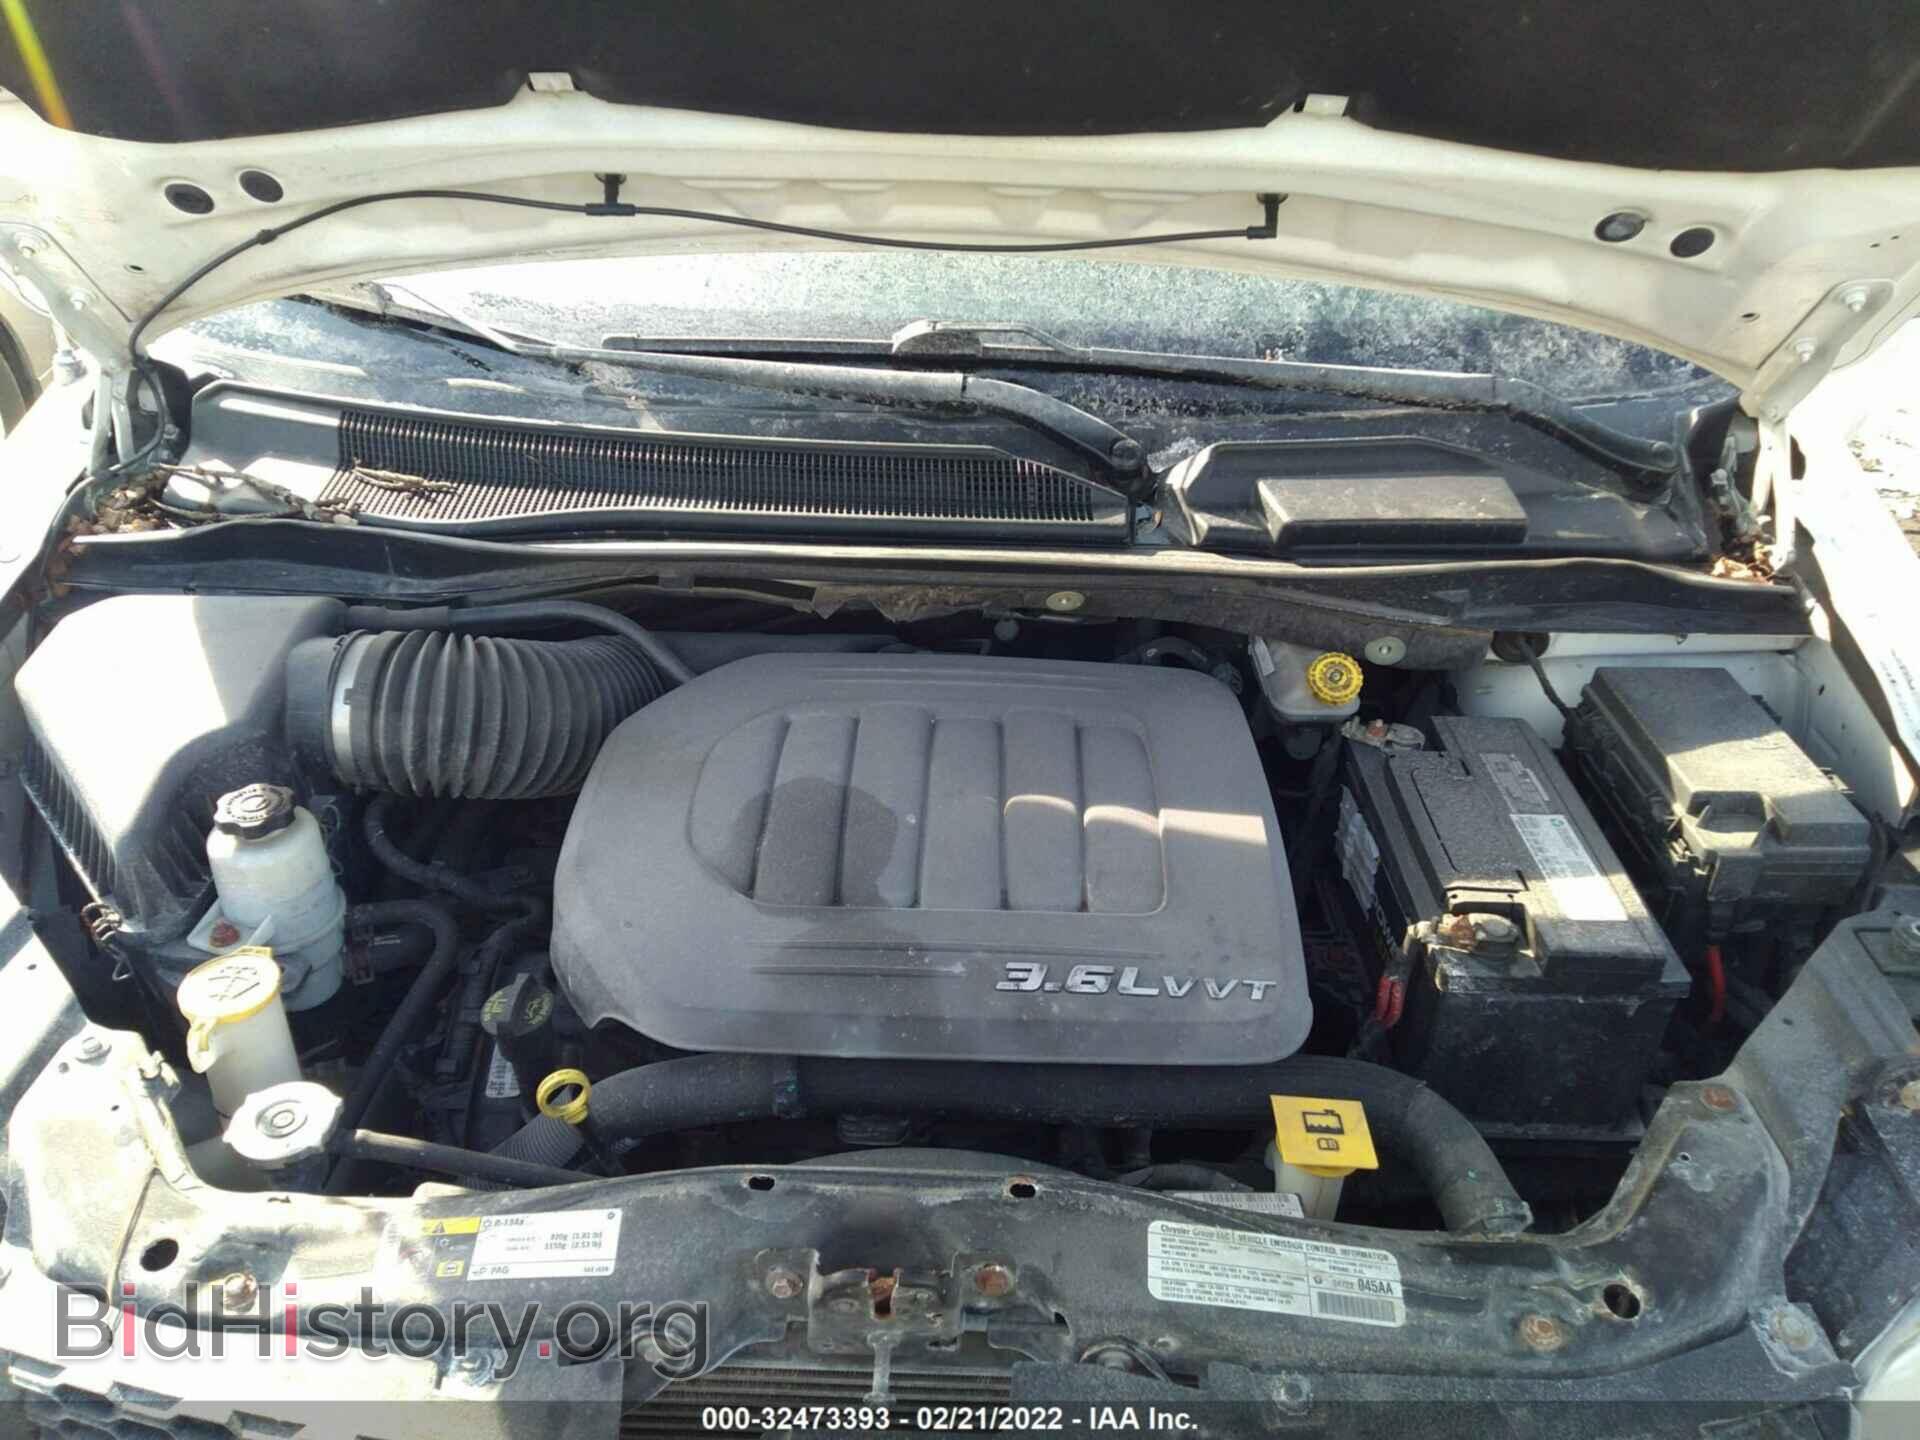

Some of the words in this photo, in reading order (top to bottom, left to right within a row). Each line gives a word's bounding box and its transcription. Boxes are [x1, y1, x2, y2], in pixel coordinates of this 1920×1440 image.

[1160, 1224, 1191, 1236] Chrysler
[1305, 1243, 1337, 1255] CONTROL
[1340, 1248, 1389, 1262] INFORMATION
[1357, 1278, 1394, 1296] 045AA
